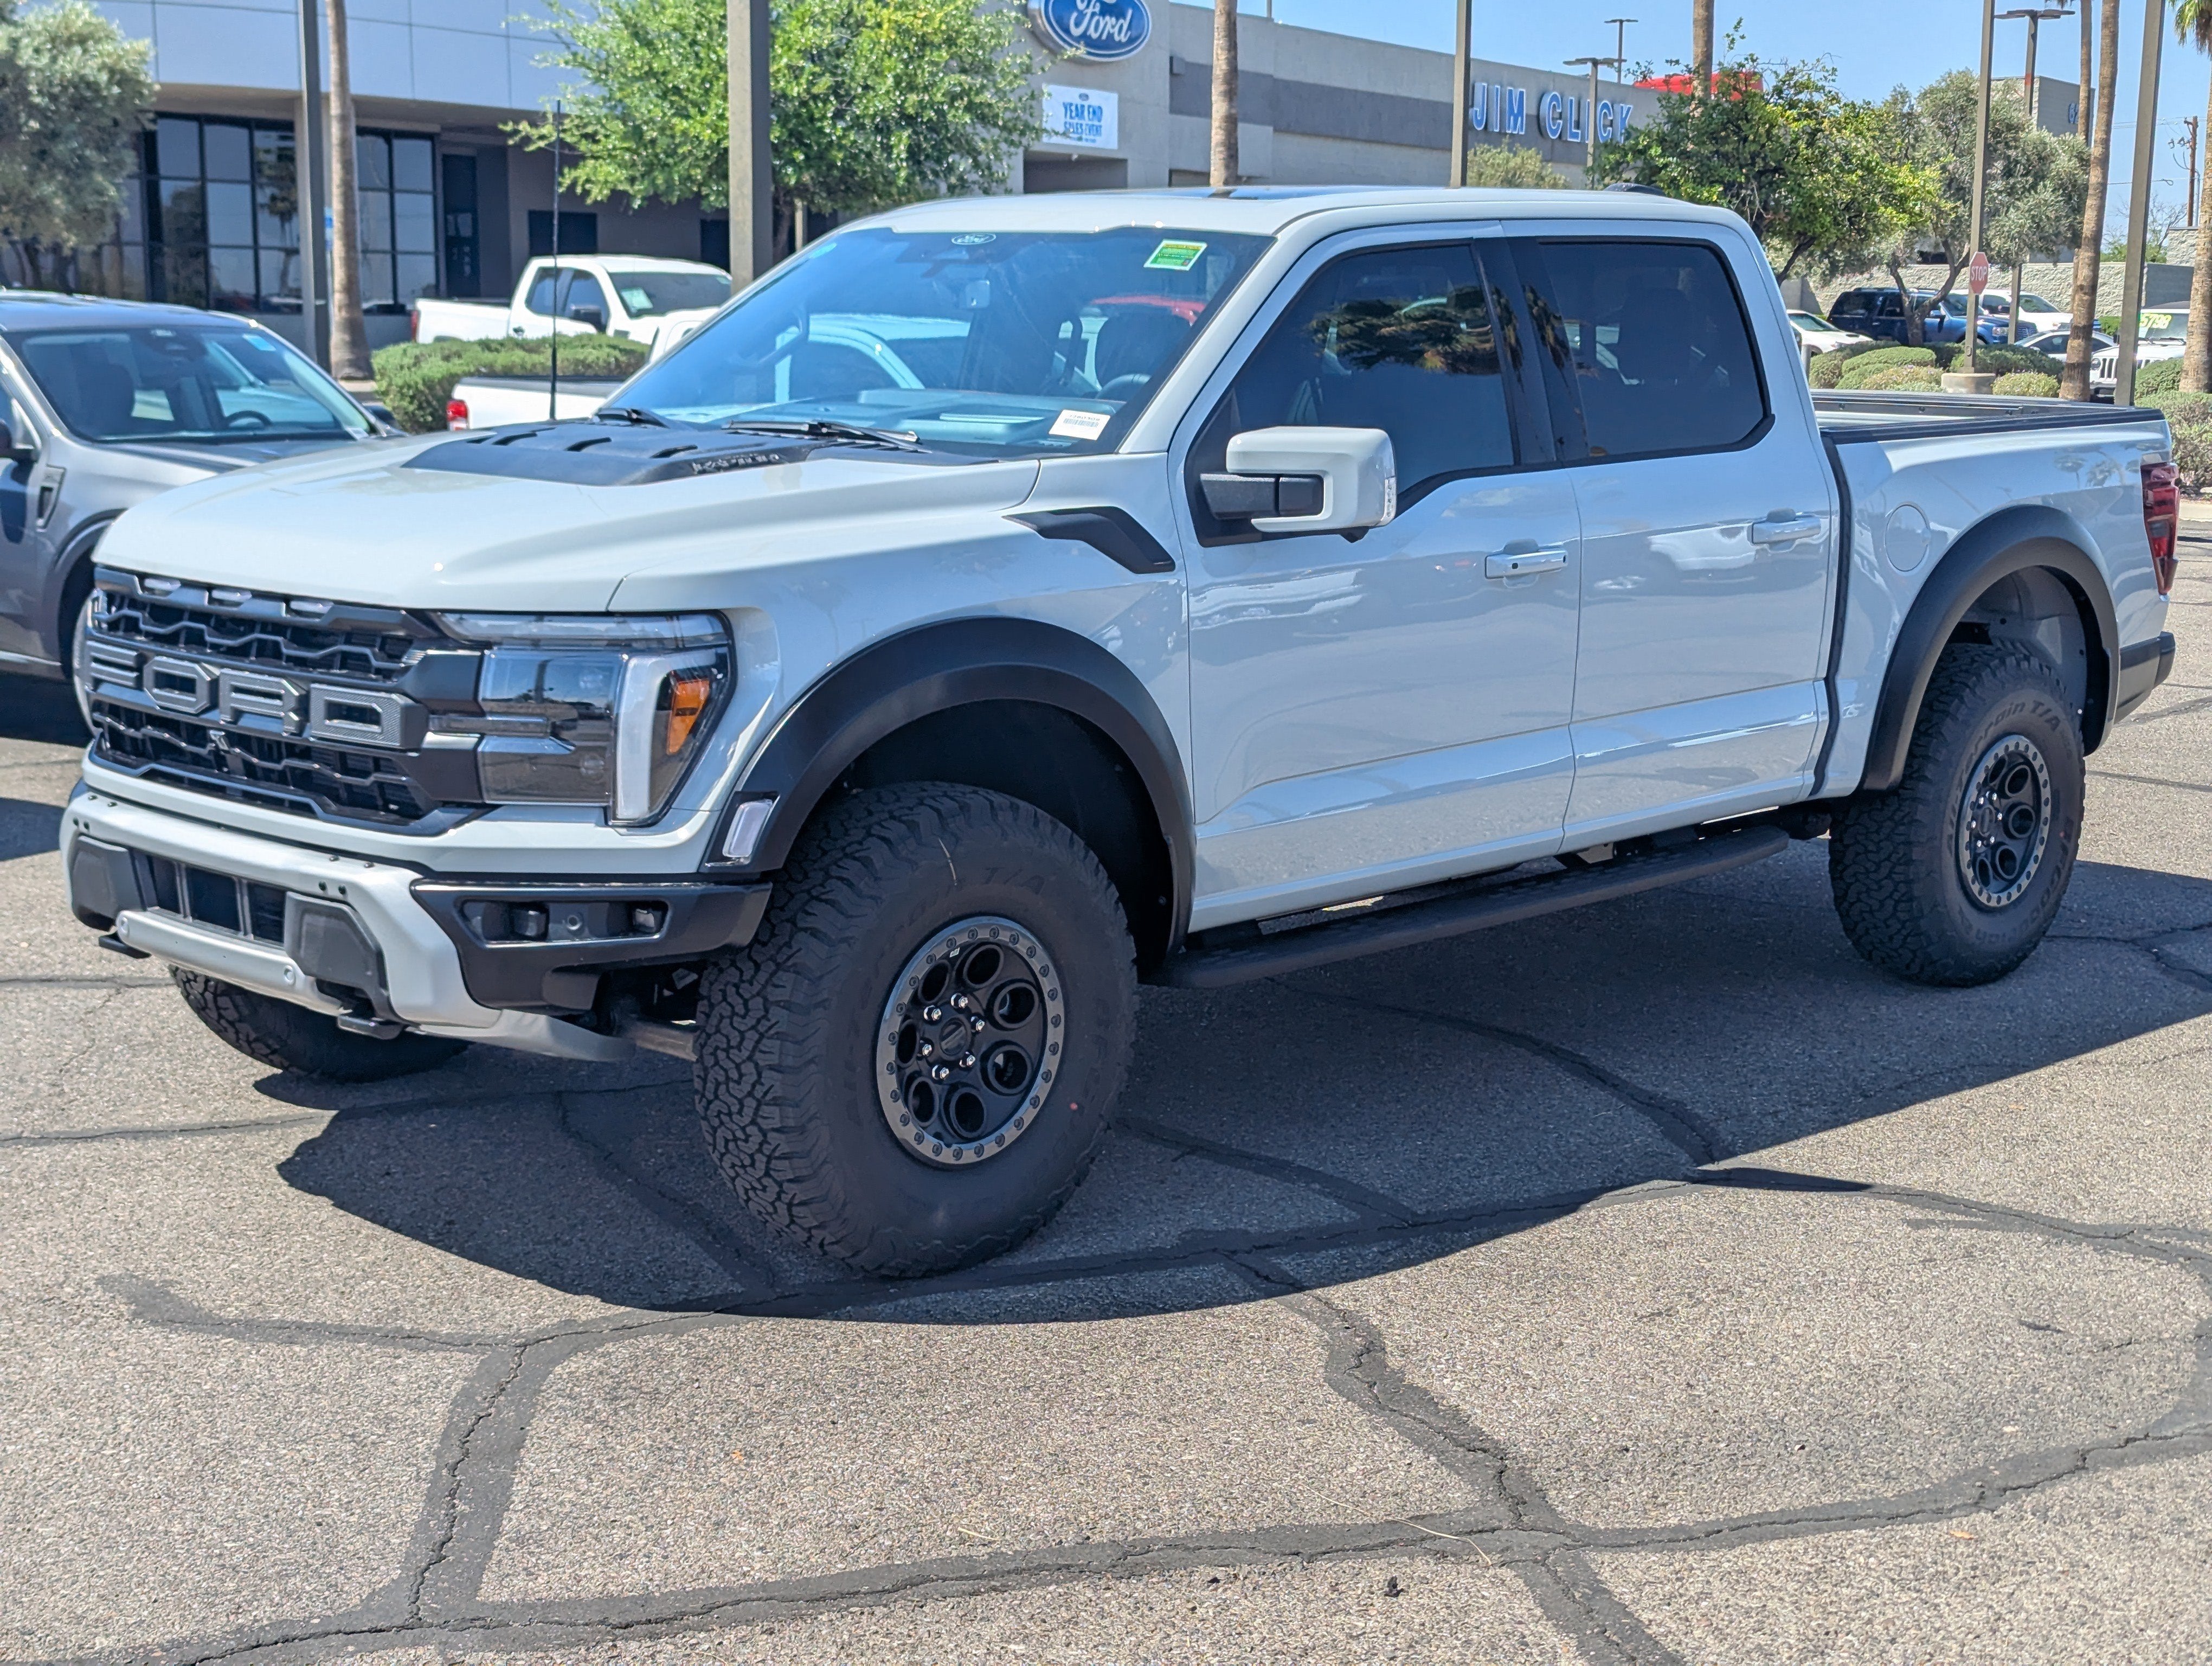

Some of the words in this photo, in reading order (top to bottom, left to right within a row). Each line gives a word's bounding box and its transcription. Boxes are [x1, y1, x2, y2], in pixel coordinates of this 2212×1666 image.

[1070, 0, 1133, 42] Ford
[1063, 101, 1085, 120] YEAR
[1472, 82, 1526, 134] JIM
[1546, 91, 1634, 145] CLICK
[1970, 266, 1988, 281] STOP
[2139, 313, 2172, 329] 5798
[86, 640, 404, 749] FORD
[2030, 700, 2061, 732] T/A
